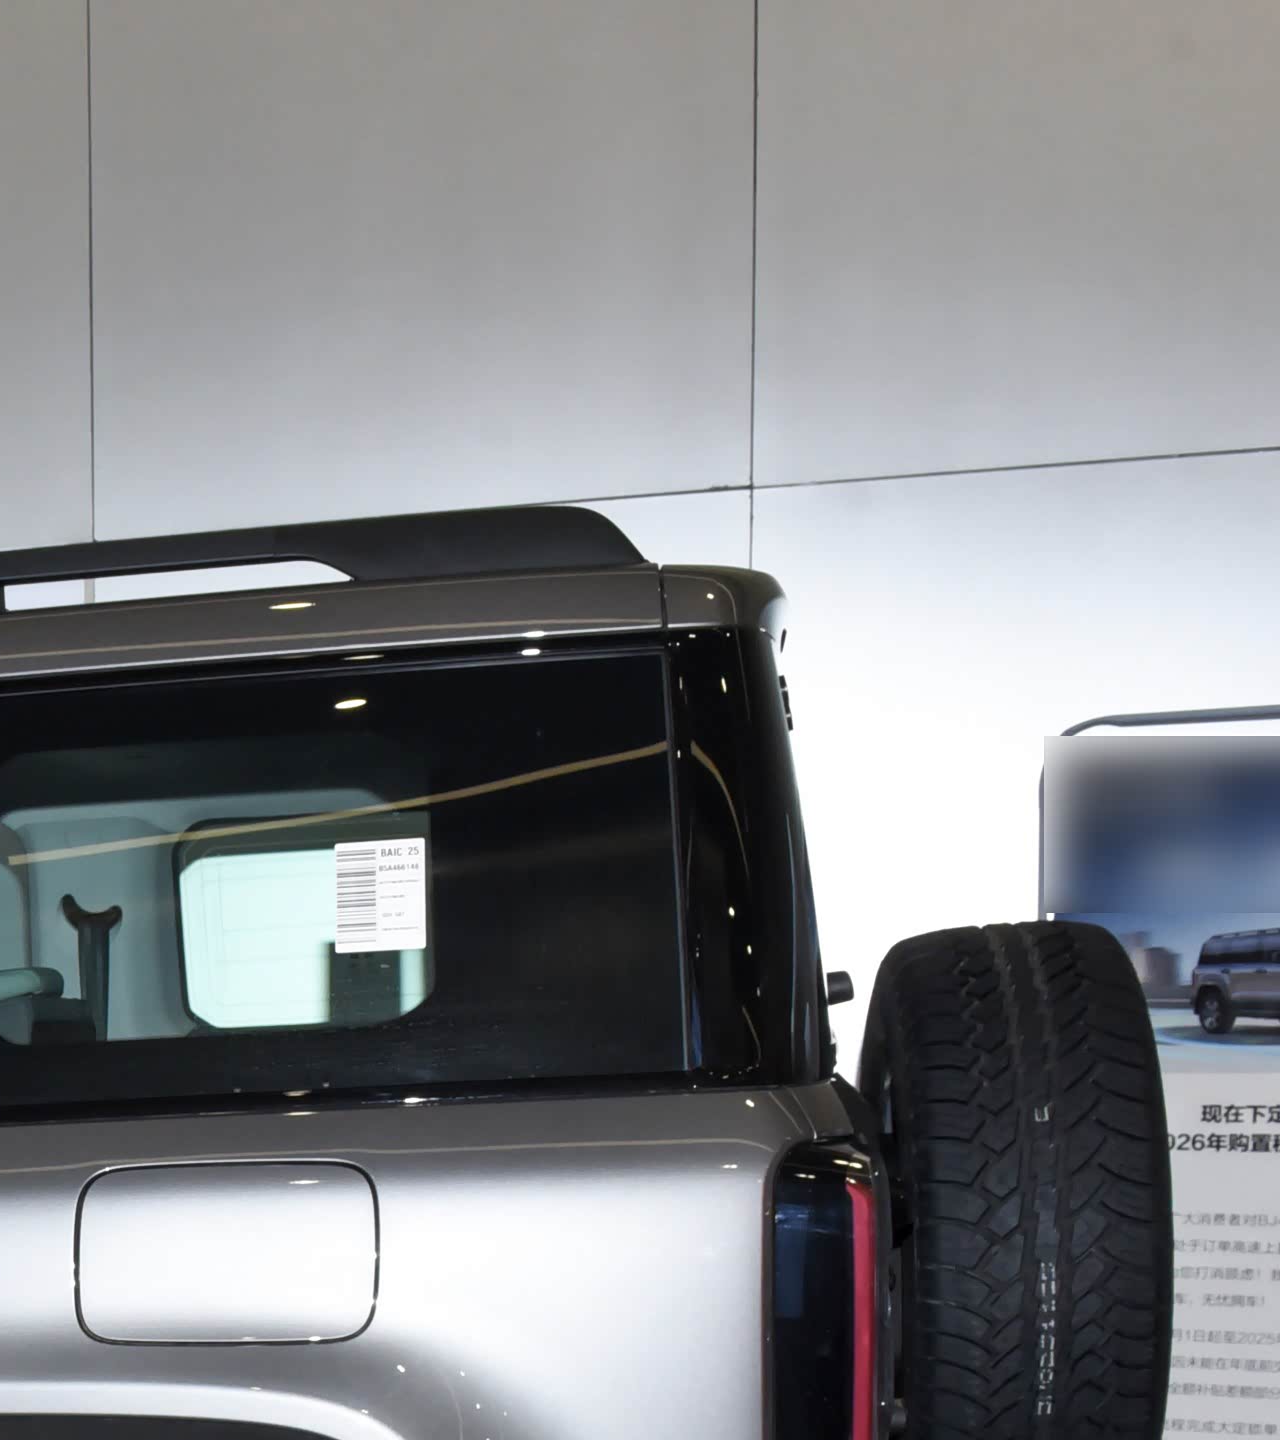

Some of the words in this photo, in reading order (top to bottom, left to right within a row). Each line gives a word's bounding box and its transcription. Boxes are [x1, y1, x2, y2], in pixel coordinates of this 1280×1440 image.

[380, 847, 403, 857] BAIC
[408, 846, 419, 856] 25
[1200, 1104, 1280, 1123] 现在下定
